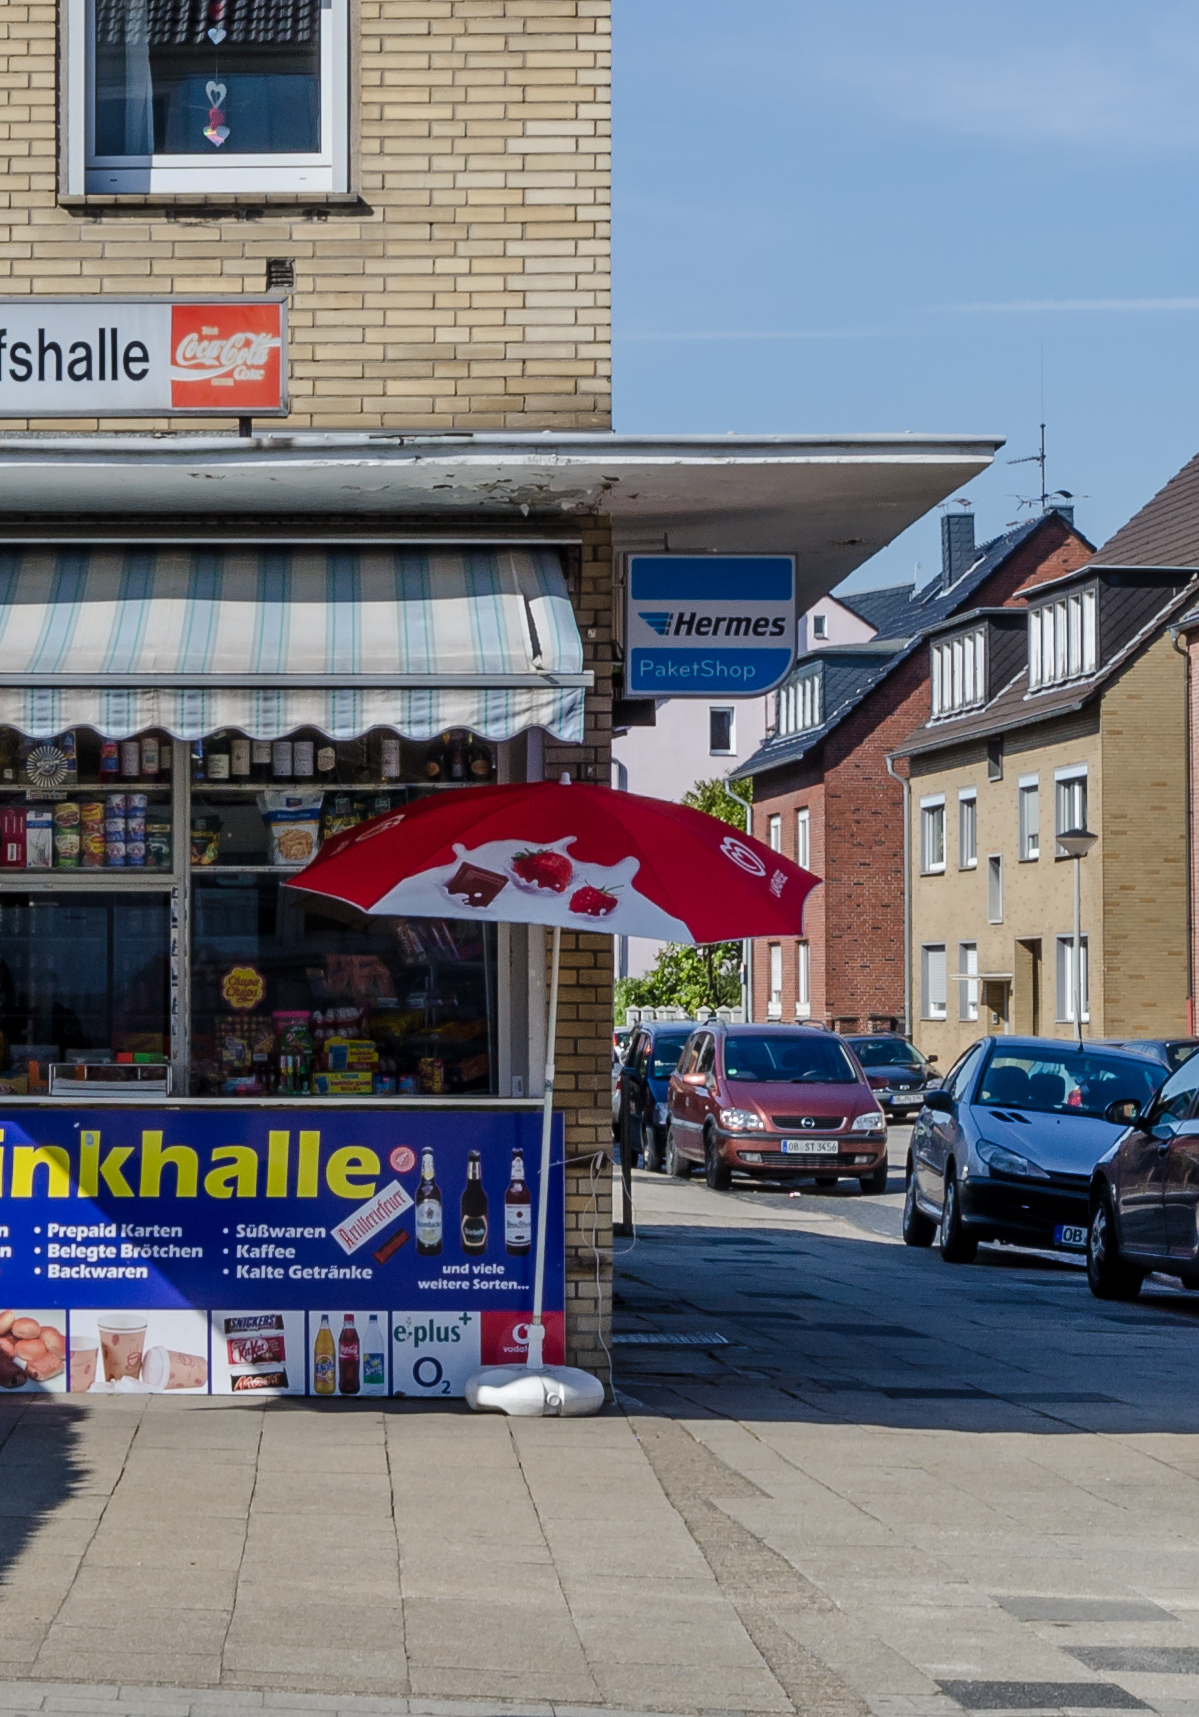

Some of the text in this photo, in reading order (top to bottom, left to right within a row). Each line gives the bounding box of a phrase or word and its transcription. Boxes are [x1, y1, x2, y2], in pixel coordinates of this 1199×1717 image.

[673, 611, 787, 637] Hermes
[639, 659, 757, 682] PaketShop
[46, 1222, 183, 1241] Prepaid Karten
[235, 1222, 327, 1239] Süßwaren
[1062, 1227, 1082, 1244] OB
[46, 1242, 204, 1263] Belegte Brötchen
[236, 1243, 296, 1259] Kaffee
[46, 1263, 148, 1279] Backwaren
[236, 1264, 373, 1282] Kalte Getränke
[442, 1263, 505, 1275] und viele
[417, 1279, 530, 1290] weitere Sorten...
[230, 1314, 276, 1329] SNICKERS
